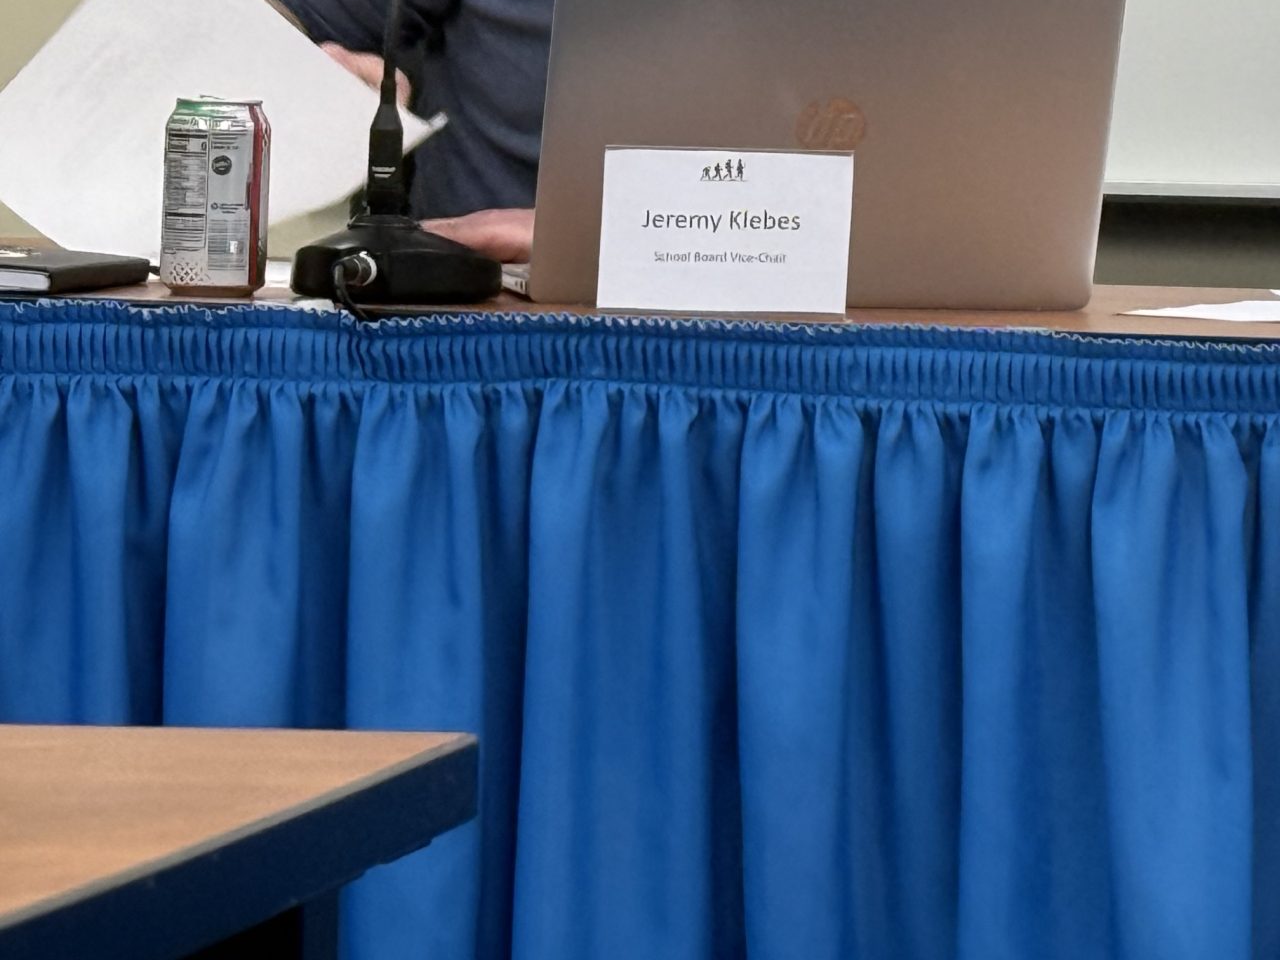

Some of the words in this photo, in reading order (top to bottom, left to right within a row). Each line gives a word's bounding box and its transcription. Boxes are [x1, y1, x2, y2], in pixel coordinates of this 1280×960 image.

[641, 209, 723, 233] Jeremy
[729, 209, 801, 231] Klebes
[654, 251, 691, 263] School
[694, 251, 727, 263] Board
